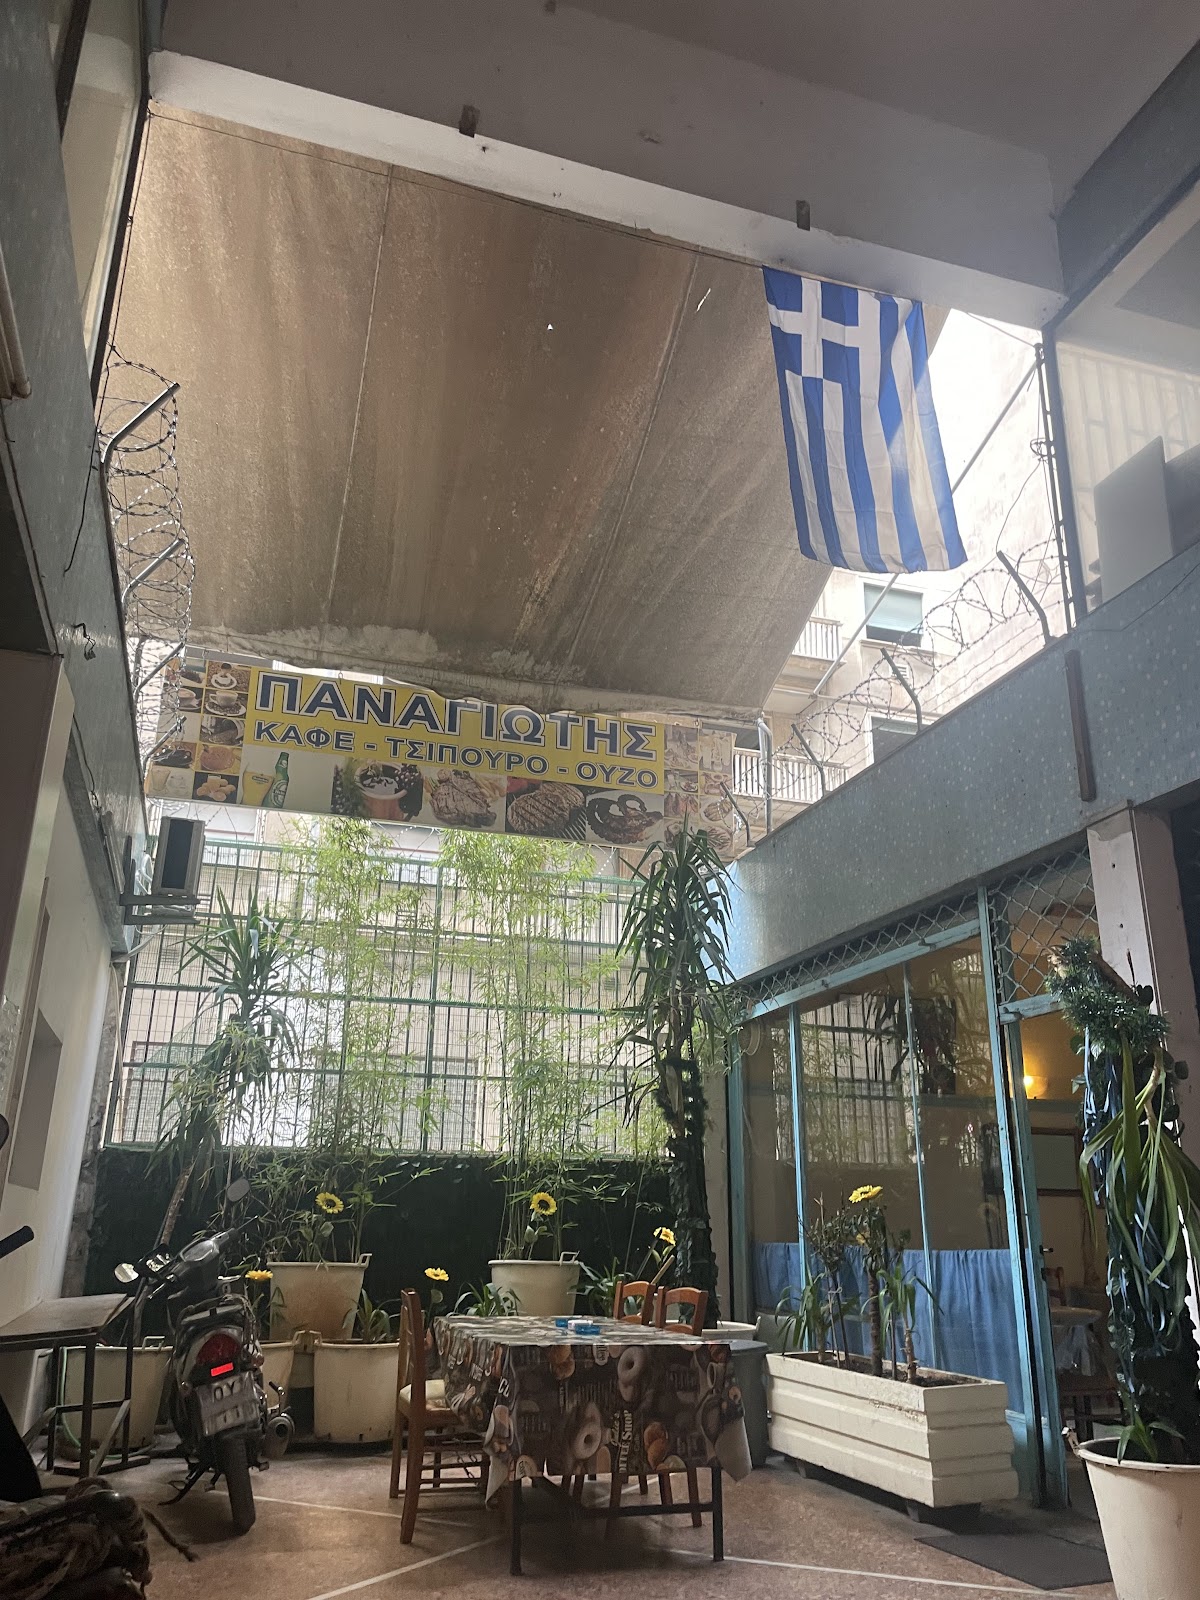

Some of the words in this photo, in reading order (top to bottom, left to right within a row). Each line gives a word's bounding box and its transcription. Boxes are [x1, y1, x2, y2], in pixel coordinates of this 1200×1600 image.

[254, 719, 355, 752] ΚΑΦΕ
[384, 736, 549, 775] ΤΣΙΠΟΥΡΟ
[575, 761, 659, 789] ΟΥΖΟ
[255, 670, 657, 761] ΠΑΝΑΓΙΩΤΗΣ
